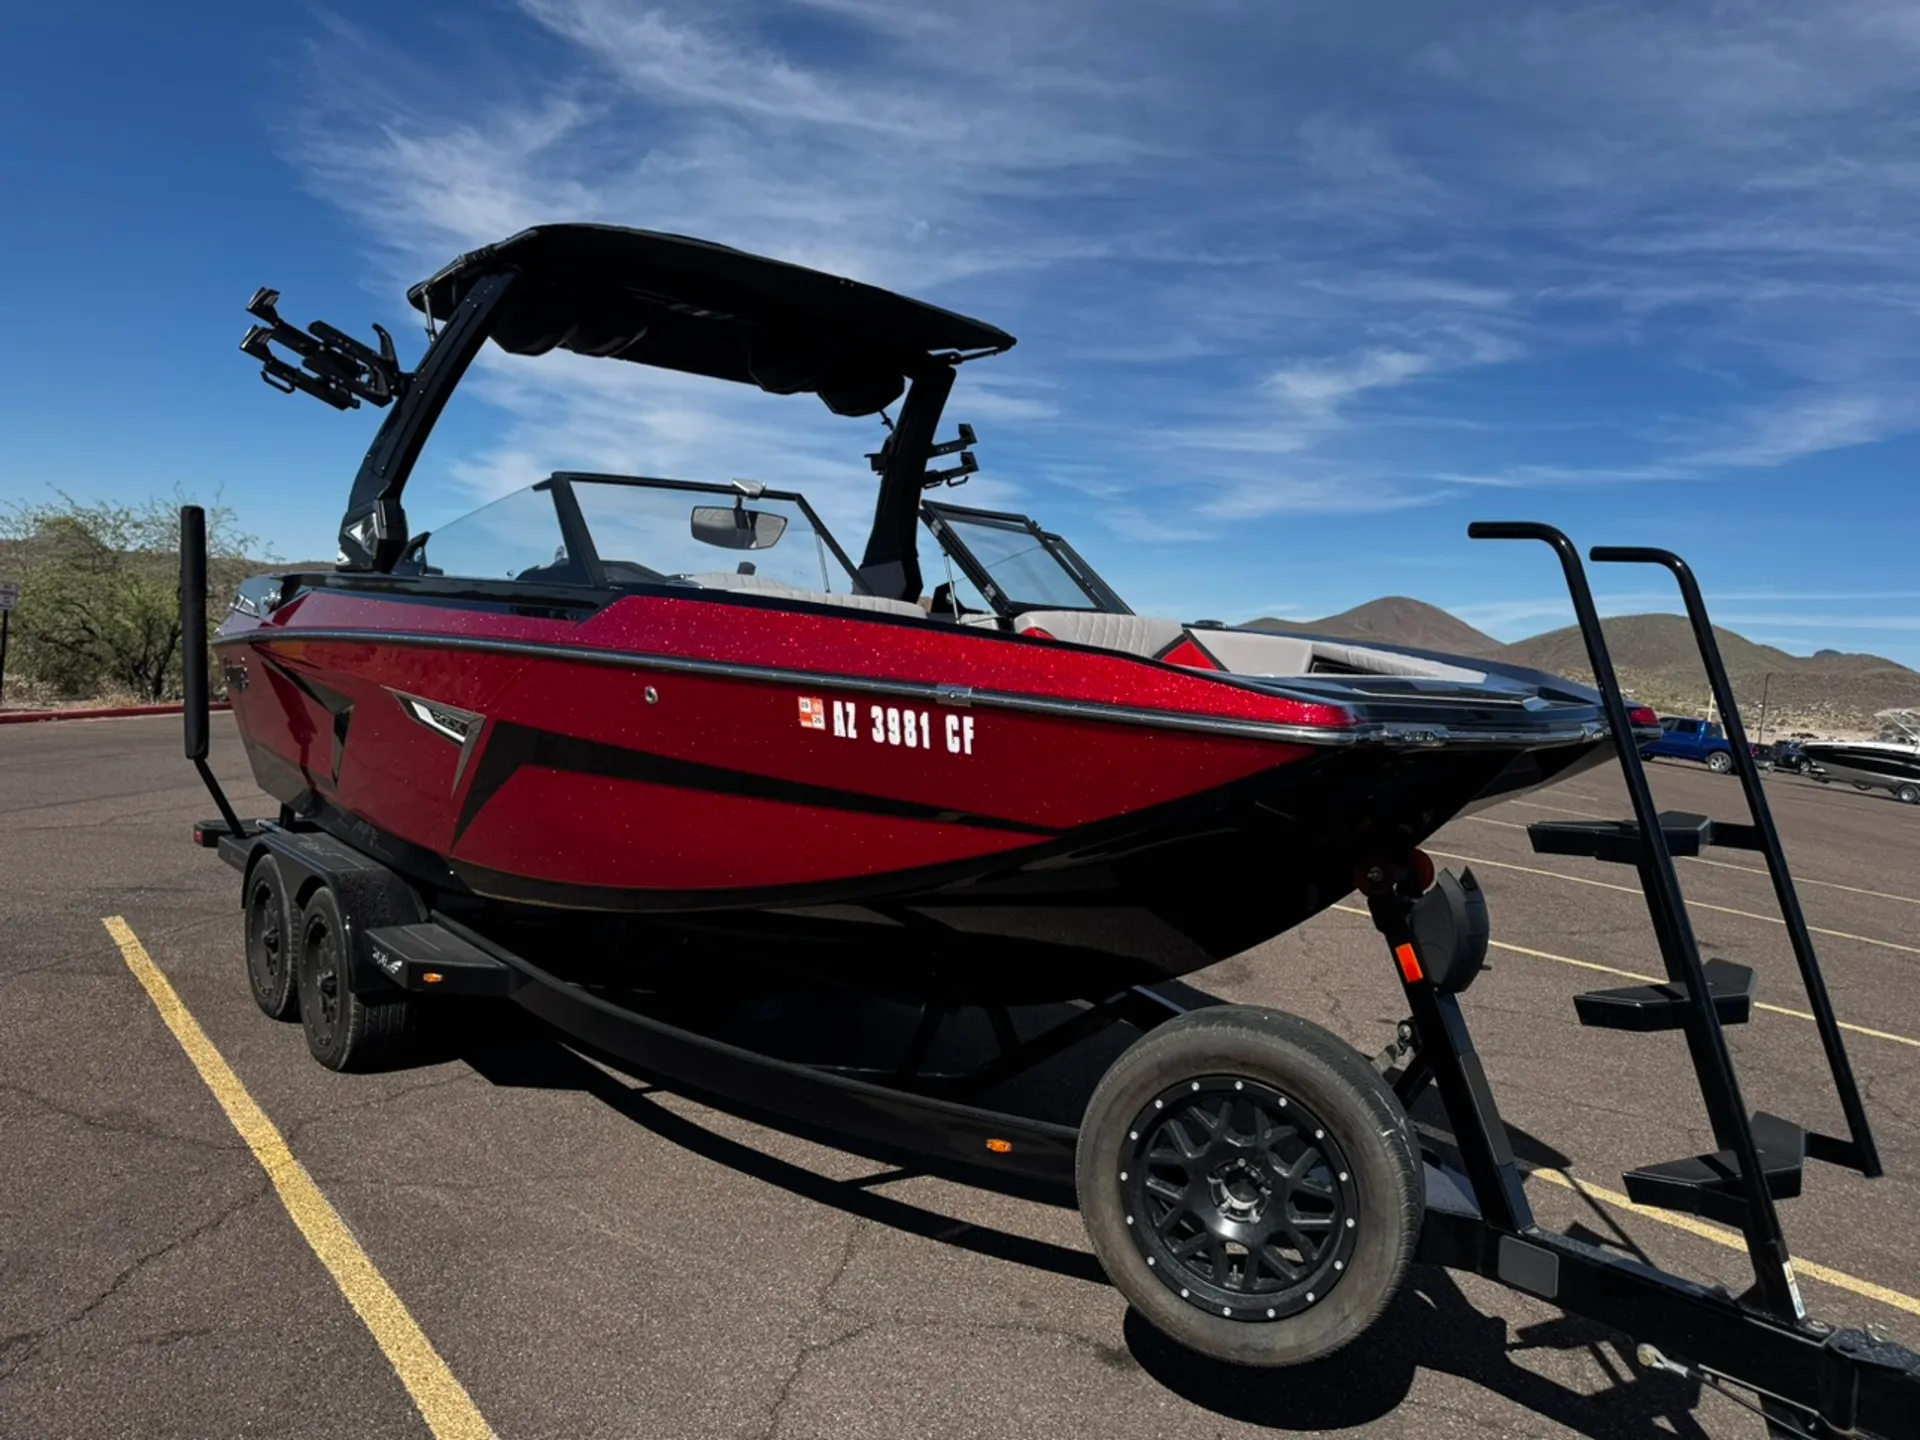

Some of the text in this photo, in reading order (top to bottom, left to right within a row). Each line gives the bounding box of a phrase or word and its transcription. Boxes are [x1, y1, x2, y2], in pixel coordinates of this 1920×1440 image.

[833, 700, 975, 755] AZ 3981 CF
